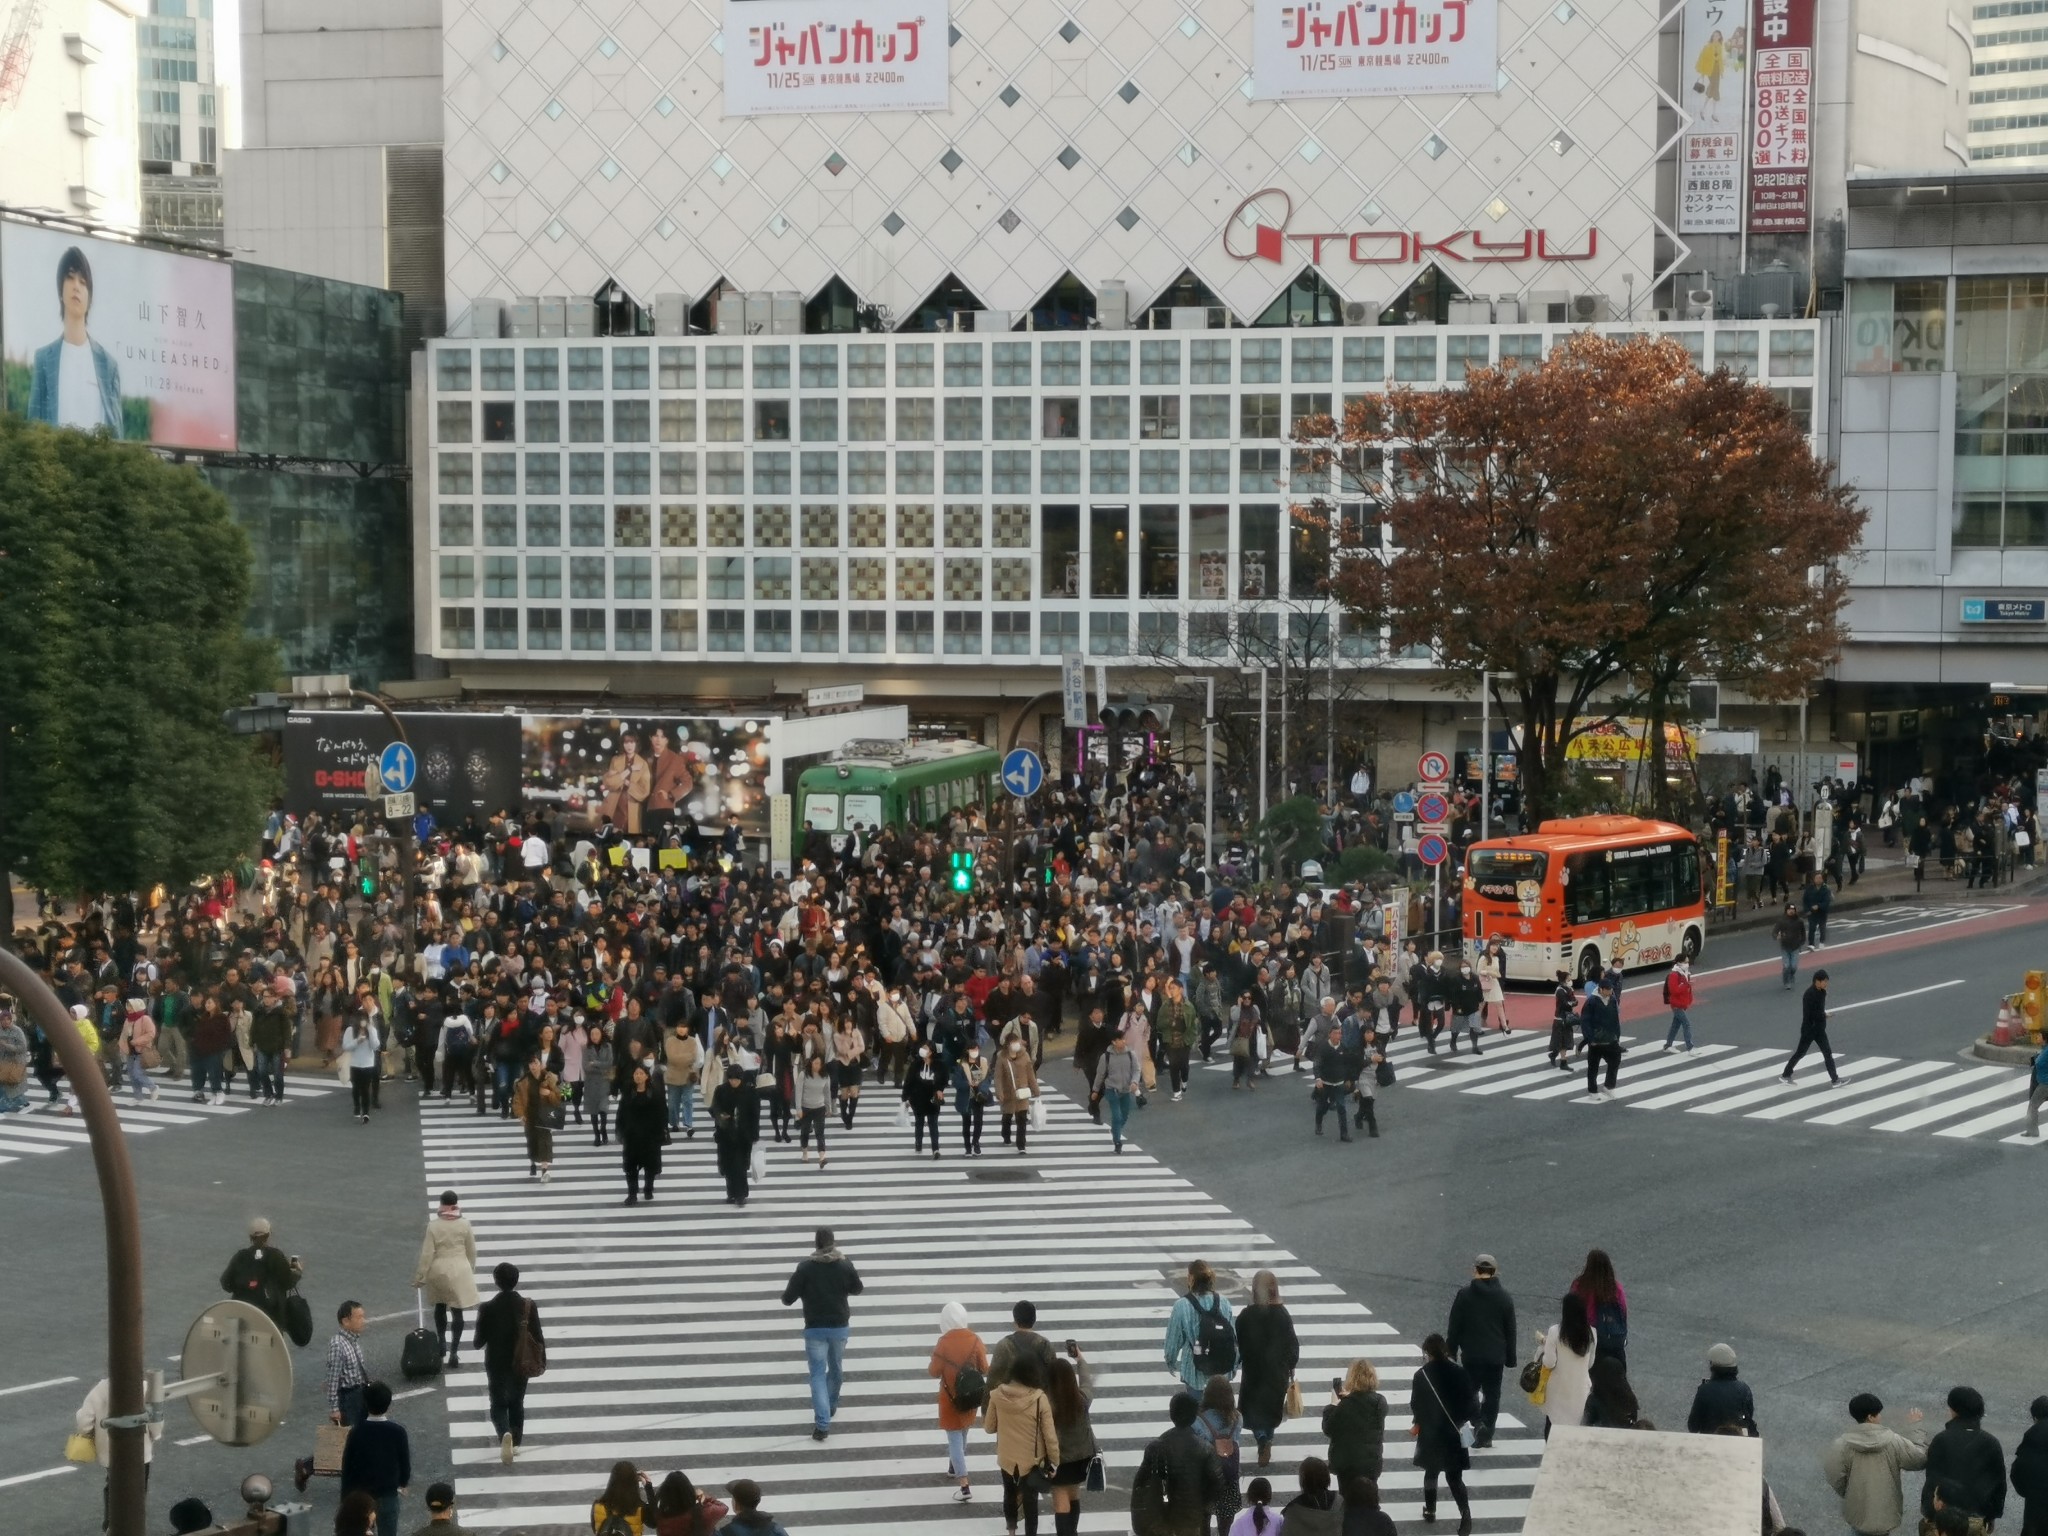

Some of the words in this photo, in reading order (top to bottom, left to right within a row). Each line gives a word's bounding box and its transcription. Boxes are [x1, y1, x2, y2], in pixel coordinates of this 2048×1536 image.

[1282, 0, 1474, 49] ジャパンカップ
[749, 16, 925, 67] ジャパンカップ
[1300, 54, 1336, 71] 11/25
[1358, 55, 1401, 67] 東京競馬場
[1407, 53, 1449, 65] 芝2400m
[767, 72, 800, 89] 11/25
[820, 73, 860, 85] 東京競馬場
[866, 71, 905, 84] 芝2400m
[1775, 88, 1790, 165] 配送ギフト
[1791, 88, 1807, 164] 全国無料
[1690, 136, 1733, 148] 新規会員
[1688, 179, 1733, 191] 西館8階
[1685, 194, 1735, 203] カスタマー
[1685, 204, 1735, 213] センターへ
[1286, 228, 1597, 267] TOKYU
[138, 300, 206, 331] 山下智久
